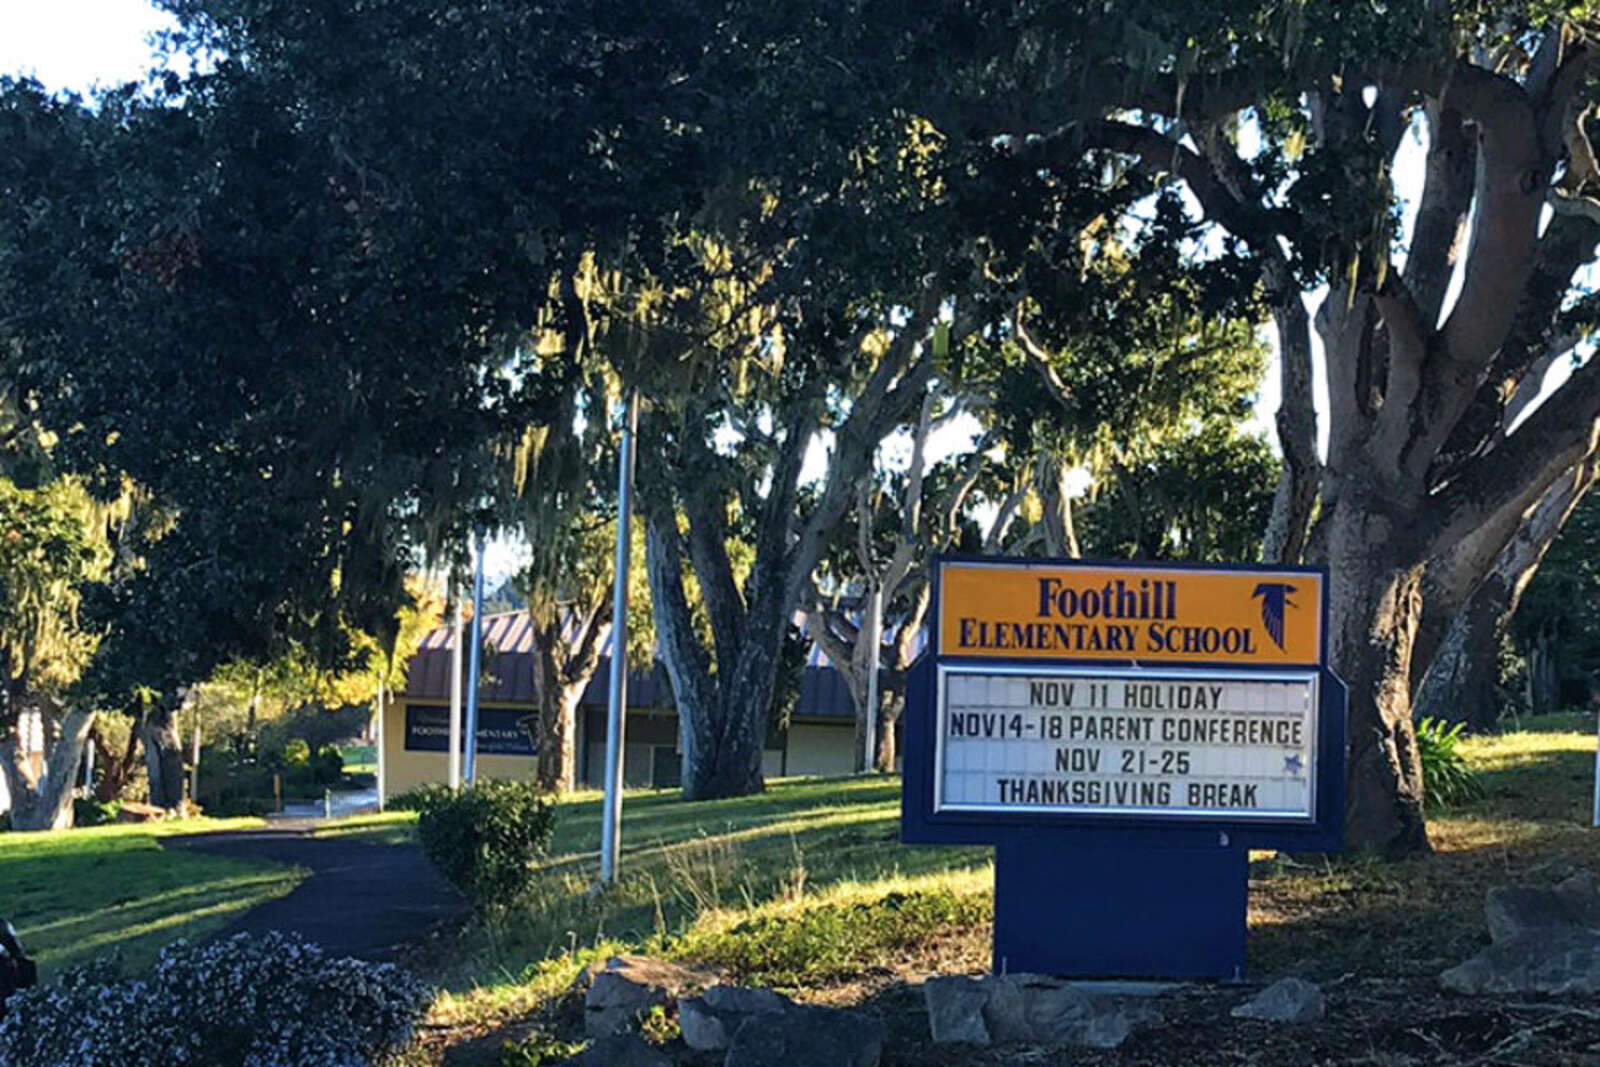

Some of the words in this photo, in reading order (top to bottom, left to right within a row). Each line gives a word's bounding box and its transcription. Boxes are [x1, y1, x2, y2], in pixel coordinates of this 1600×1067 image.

[1038, 578, 1177, 620] Foothill
[958, 618, 1139, 652] ELEMENTARY
[1146, 622, 1257, 655] SCHOOL
[1030, 682, 1075, 706] NOV
[1090, 684, 1108, 708] 11
[1124, 685, 1223, 710] HOLIDAY
[411, 725, 457, 737] FOOTH
[1069, 716, 1154, 742] PARENT
[1162, 718, 1302, 745] CONFERENCE
[1055, 748, 1101, 772] NOV
[1122, 750, 1190, 775] 21-25
[997, 779, 1171, 806] THANKSGIVING
[1188, 783, 1258, 809] BREAK
